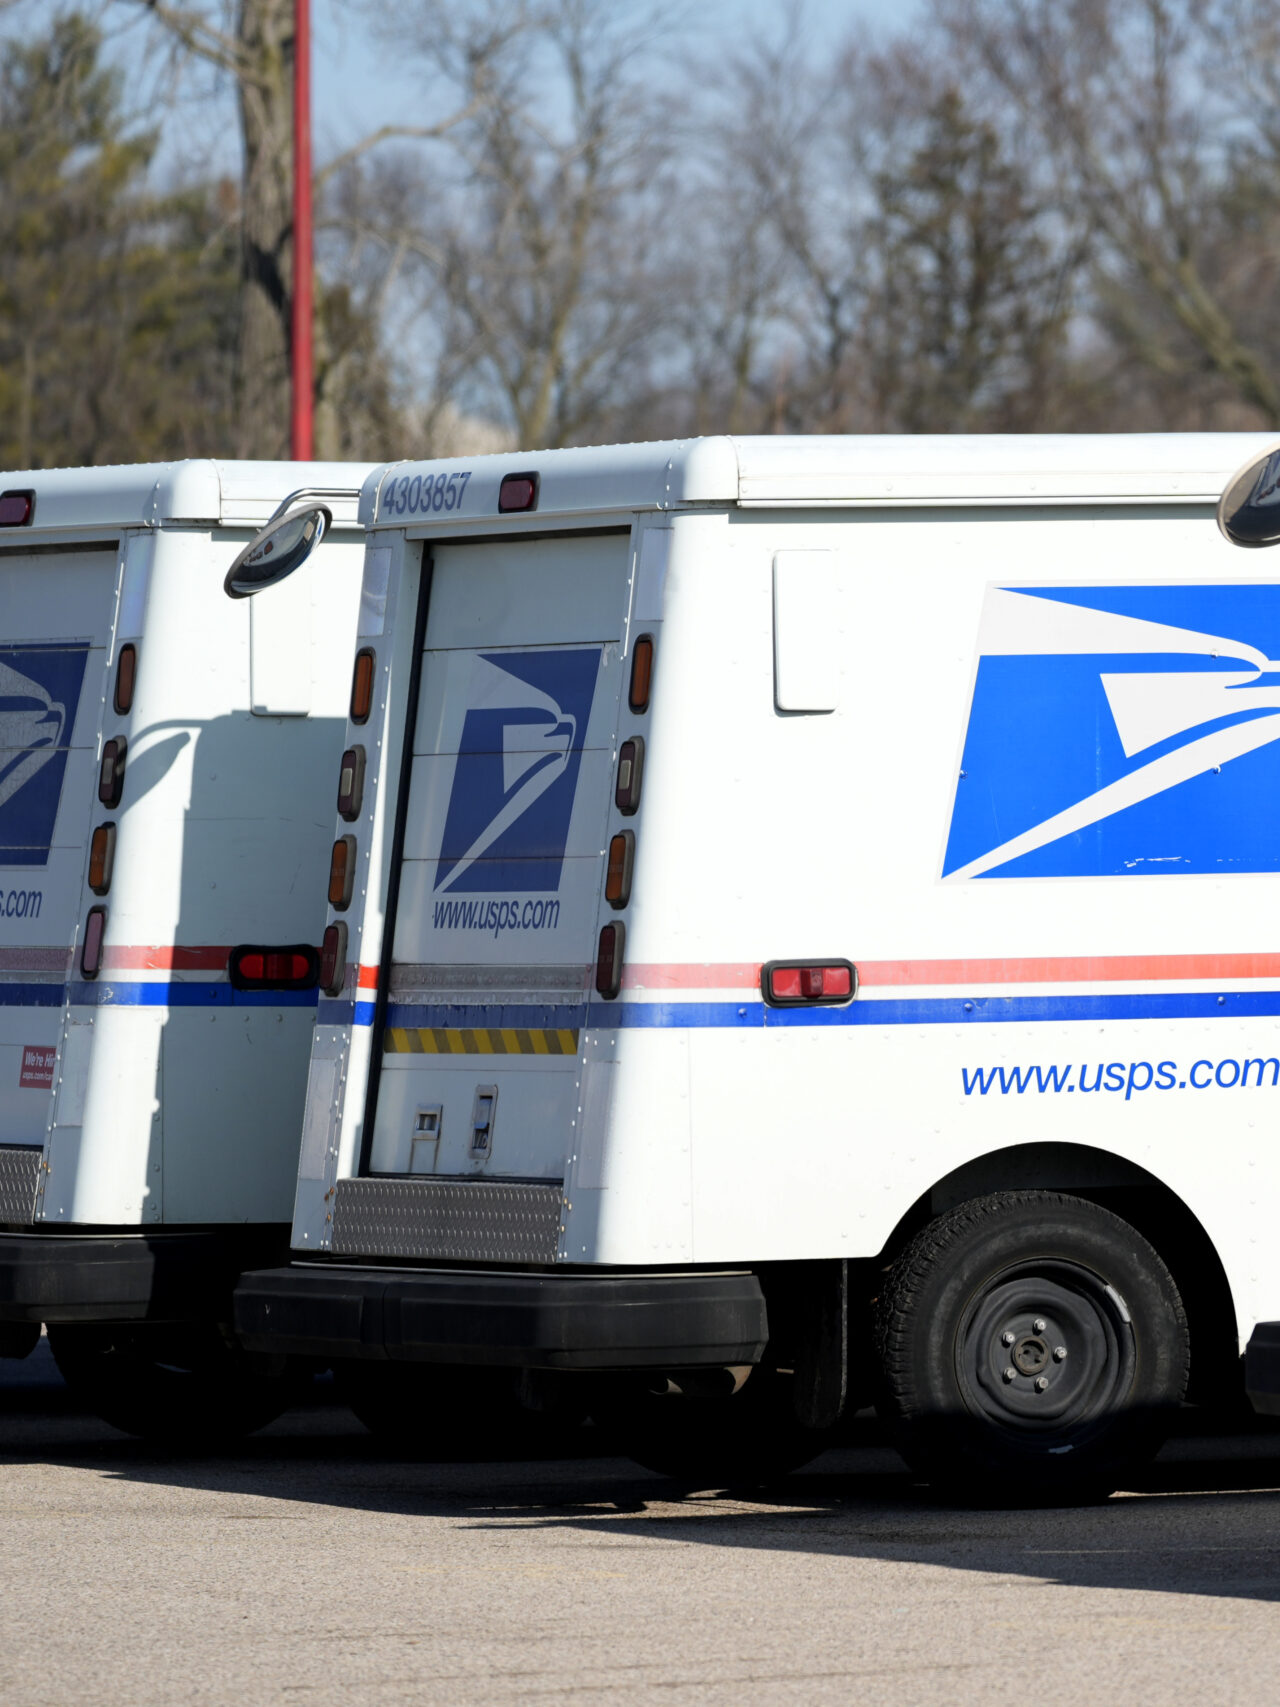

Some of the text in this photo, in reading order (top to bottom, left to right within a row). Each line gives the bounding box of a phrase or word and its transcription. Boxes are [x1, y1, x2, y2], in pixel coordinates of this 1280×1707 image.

[383, 471, 472, 515] 4303857
[433, 899, 560, 939] www.usps.com
[961, 1057, 1280, 1101] www.usps.com
